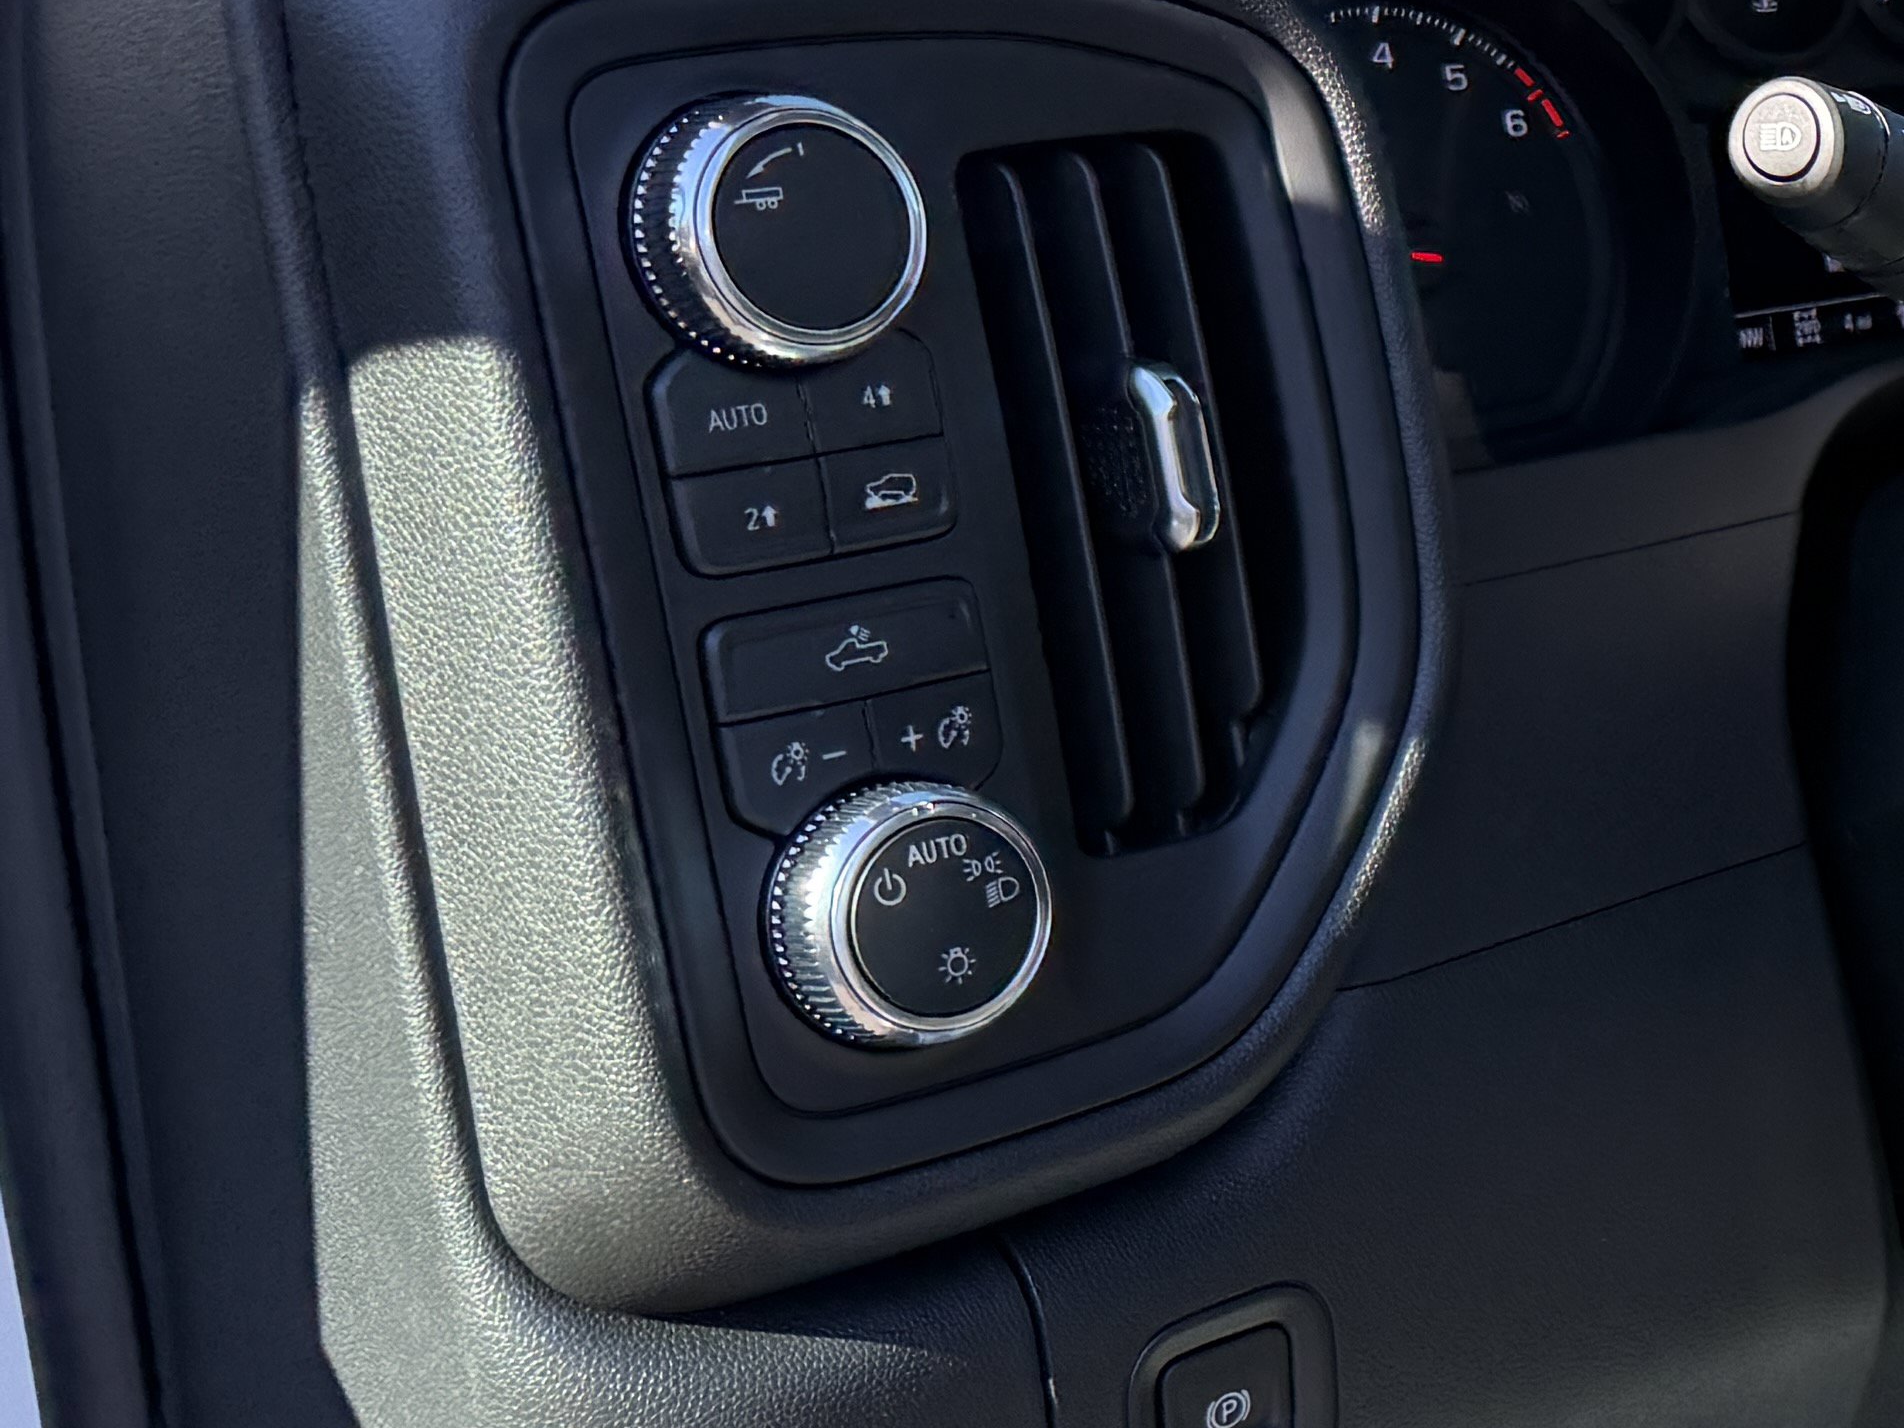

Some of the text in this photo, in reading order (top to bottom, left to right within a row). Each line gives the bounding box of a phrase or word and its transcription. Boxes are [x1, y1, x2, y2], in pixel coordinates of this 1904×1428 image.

[1371, 42, 1394, 69] 4
[1444, 64, 1468, 91] 5
[1503, 109, 1528, 137] 6
[708, 403, 768, 433] AUTO
[744, 507, 761, 530] 2
[907, 833, 968, 867] AUTO
